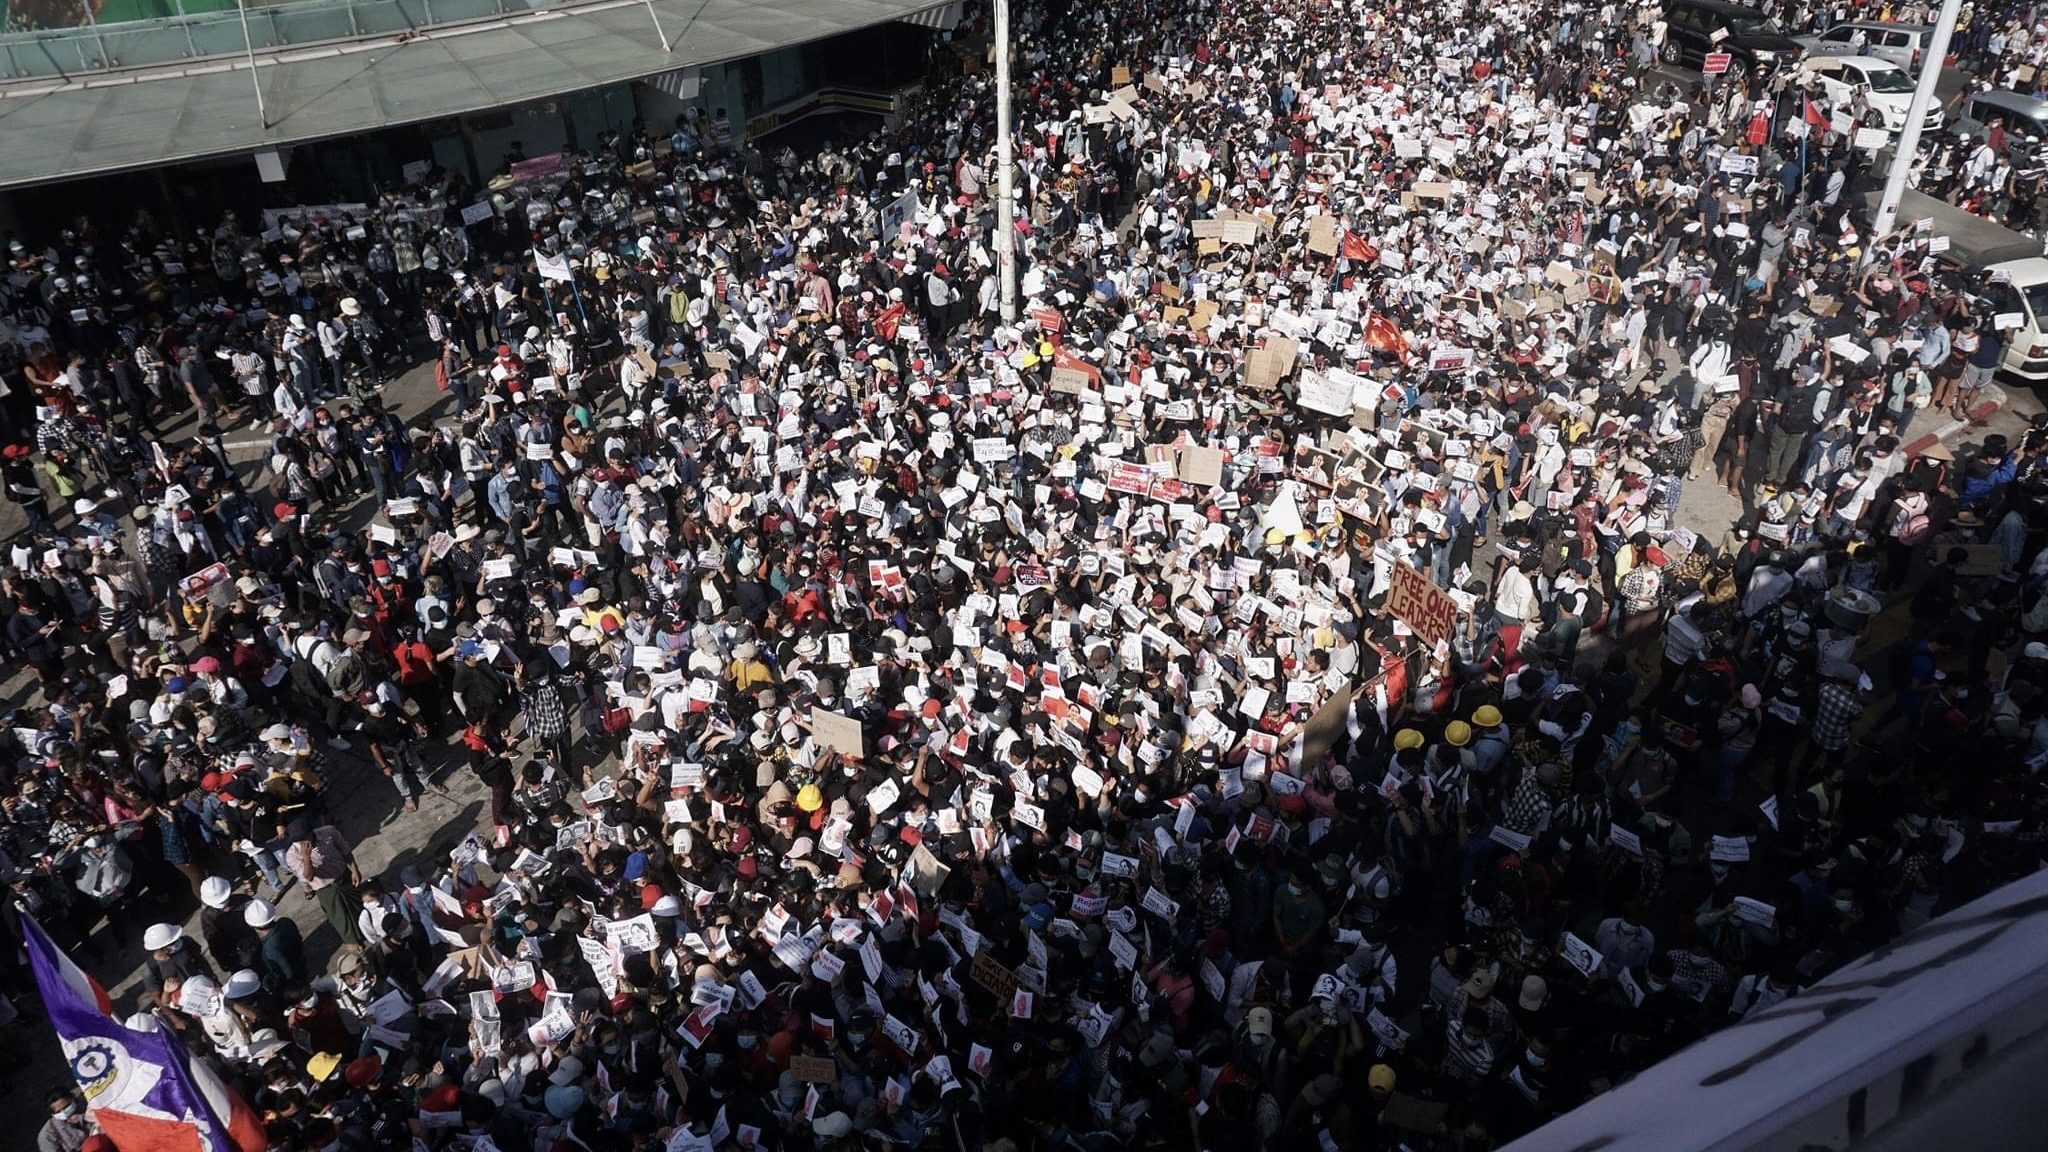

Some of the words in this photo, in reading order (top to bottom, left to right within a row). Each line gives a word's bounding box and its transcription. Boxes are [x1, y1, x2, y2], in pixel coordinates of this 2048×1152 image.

[1388, 585, 1452, 643] LEADERS!
[1393, 563, 1427, 605] FREE
[1427, 589, 1457, 628] OUR
[973, 965, 1014, 1002] DICTATO
